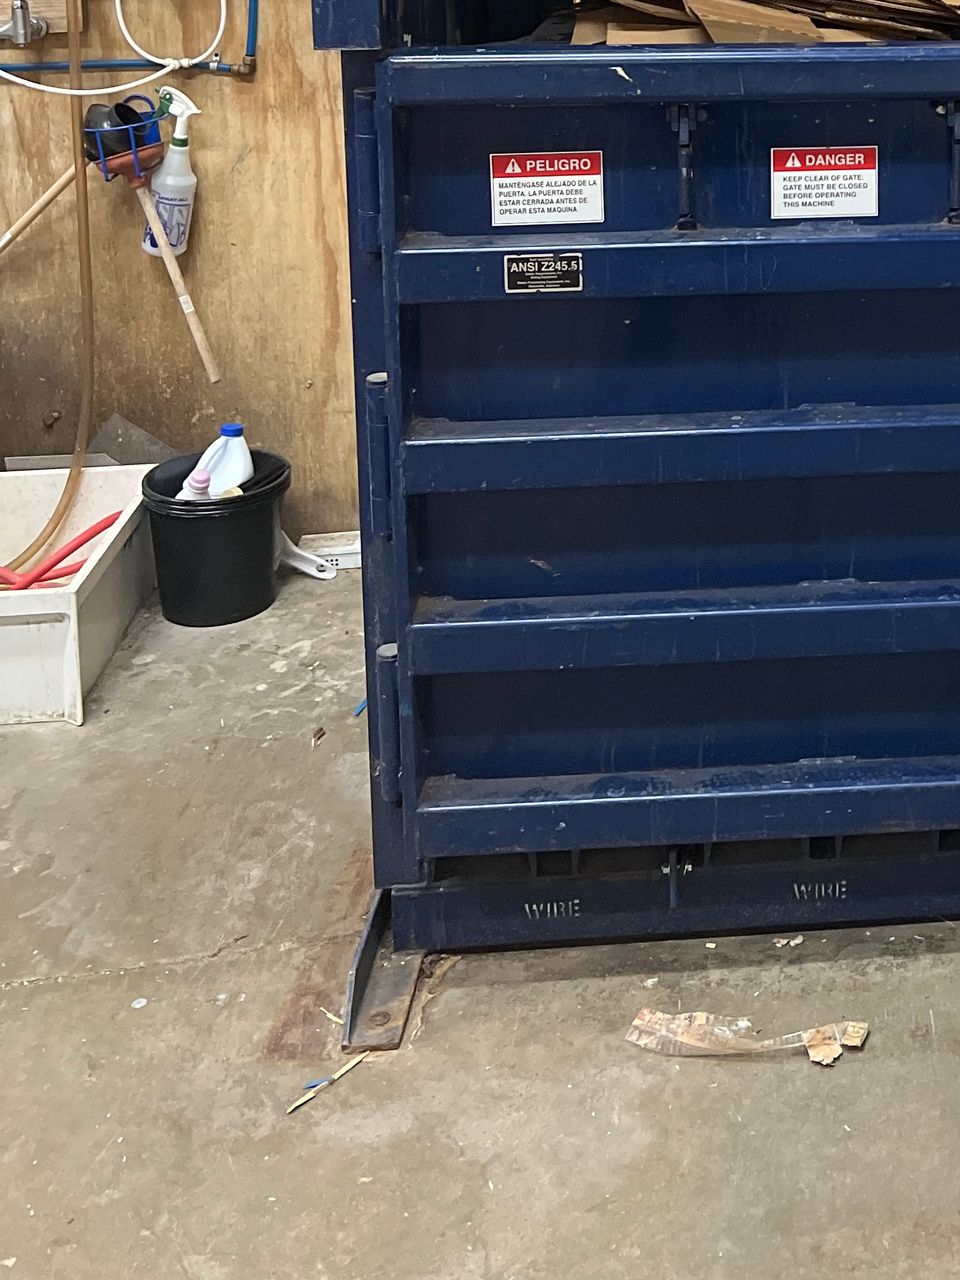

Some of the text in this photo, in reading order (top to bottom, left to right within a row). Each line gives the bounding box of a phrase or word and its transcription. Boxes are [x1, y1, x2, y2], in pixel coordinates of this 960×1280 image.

[527, 159, 591, 172] PELIGRO
[806, 154, 864, 166] DANGER
[510, 261, 577, 272] ANSI Z245.5
[793, 881, 847, 900] WIRE
[524, 899, 581, 919] WIRE
